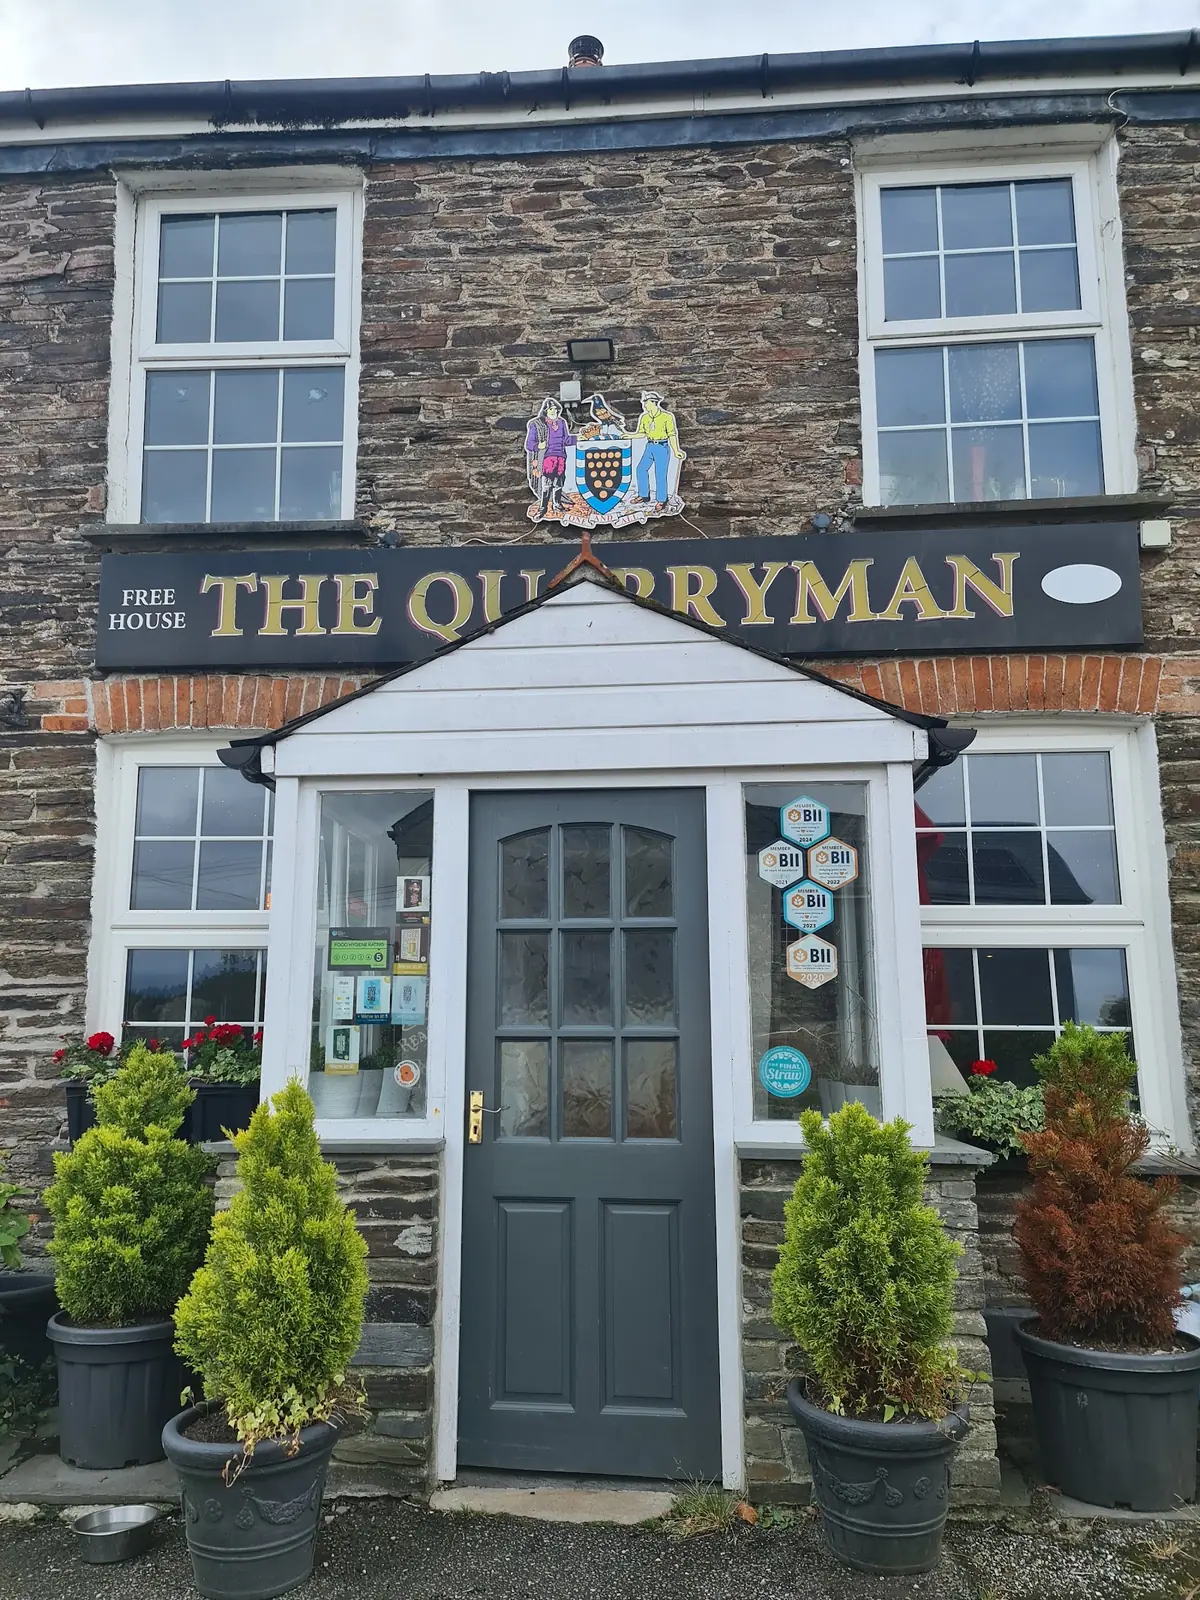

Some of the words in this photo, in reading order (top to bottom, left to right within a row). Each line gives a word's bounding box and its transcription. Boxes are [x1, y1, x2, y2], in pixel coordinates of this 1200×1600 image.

[569, 515, 586, 524] ONE
[621, 514, 639, 524] ALL
[121, 588, 176, 606] FREE
[201, 571, 382, 638] THE
[407, 552, 1021, 643] QURYMAN
[108, 612, 186, 630] HOUSE
[803, 809, 822, 822] BII
[779, 853, 799, 867] BII
[831, 851, 850, 864] BII
[807, 894, 826, 908] BII
[810, 948, 831, 963] BII
[800, 973, 825, 982] 2020
[767, 1067, 802, 1080] Straw
